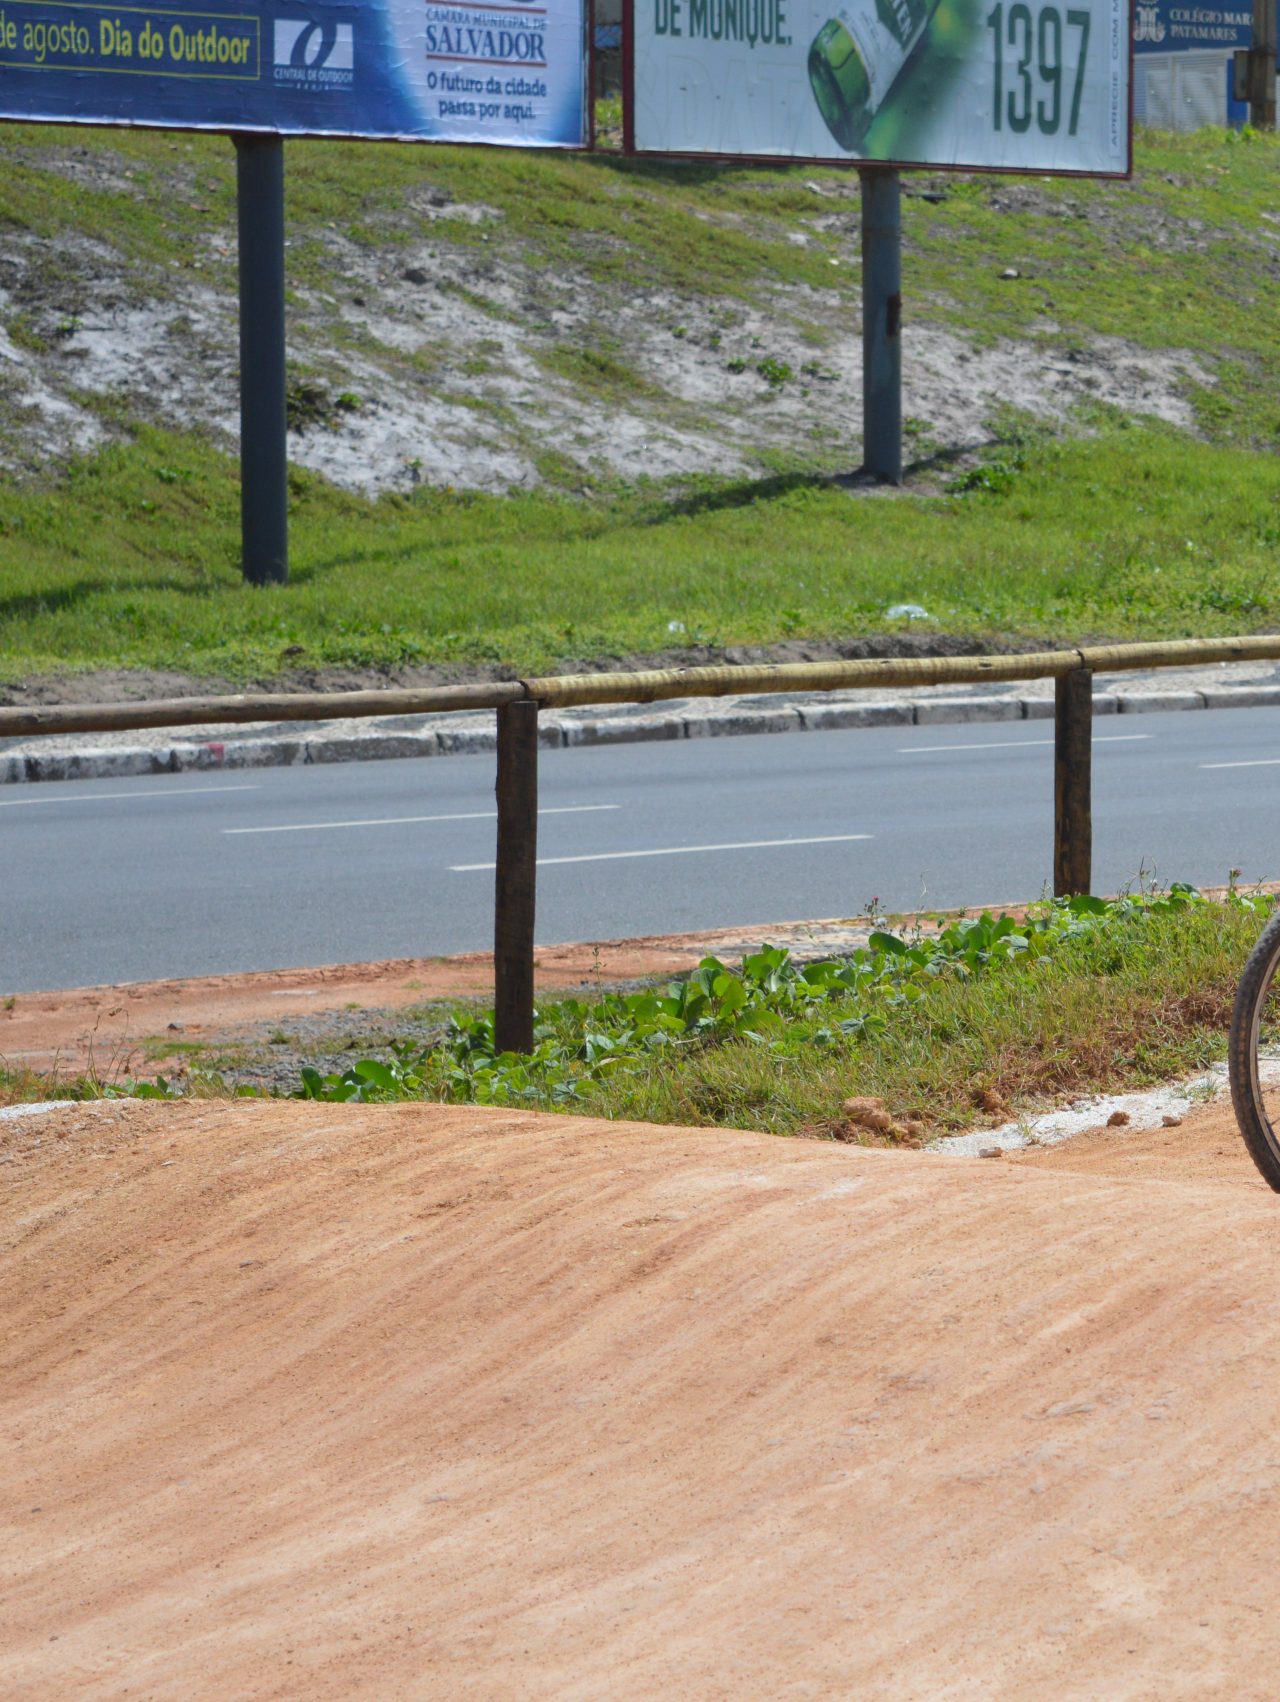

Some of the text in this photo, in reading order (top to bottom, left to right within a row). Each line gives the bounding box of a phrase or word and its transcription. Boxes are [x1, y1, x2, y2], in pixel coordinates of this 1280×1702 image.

[655, 0, 793, 49] DE MUNIQUE.
[1169, 7, 1221, 25] COLÉGIO
[1170, 25, 1238, 41] PATAMARES
[23, 19, 95, 63] agosto.
[100, 18, 132, 57] Dia
[138, 20, 164, 60] do
[169, 24, 251, 64] Outdoor
[425, 24, 547, 60] SALVADOR
[1111, 19, 1119, 60] COM
[427, 71, 547, 98] O futuro da cidade
[987, 2, 1091, 137] 1397
[439, 99, 536, 124] passa por aqui.
